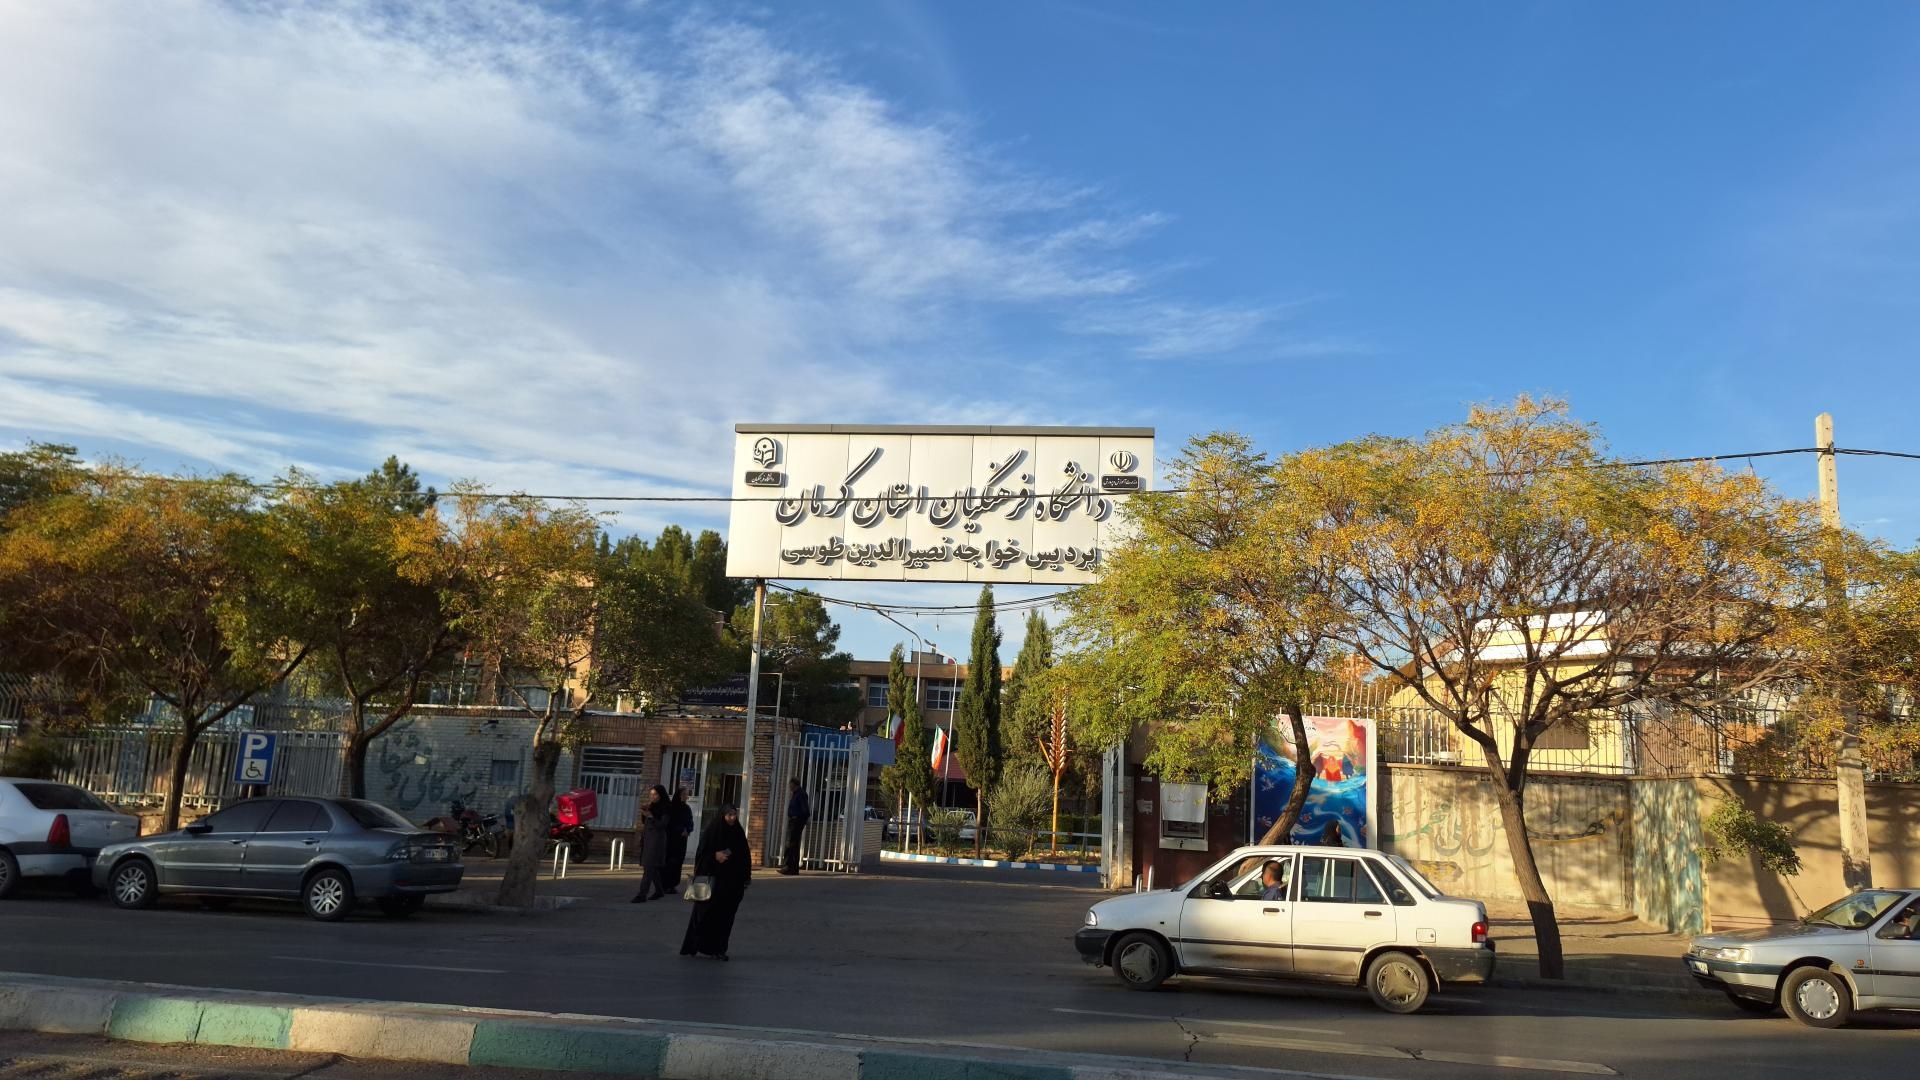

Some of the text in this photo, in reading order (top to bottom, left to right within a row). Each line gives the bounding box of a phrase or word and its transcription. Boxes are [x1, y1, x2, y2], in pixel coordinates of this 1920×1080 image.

[775, 446, 1107, 533] دانشگاه فرهنگیان استان کرمان
[781, 536, 845, 565] طوسی
[952, 537, 1022, 568] خواجه
[1025, 545, 1097, 572] پردیس
[244, 733, 268, 758] P
